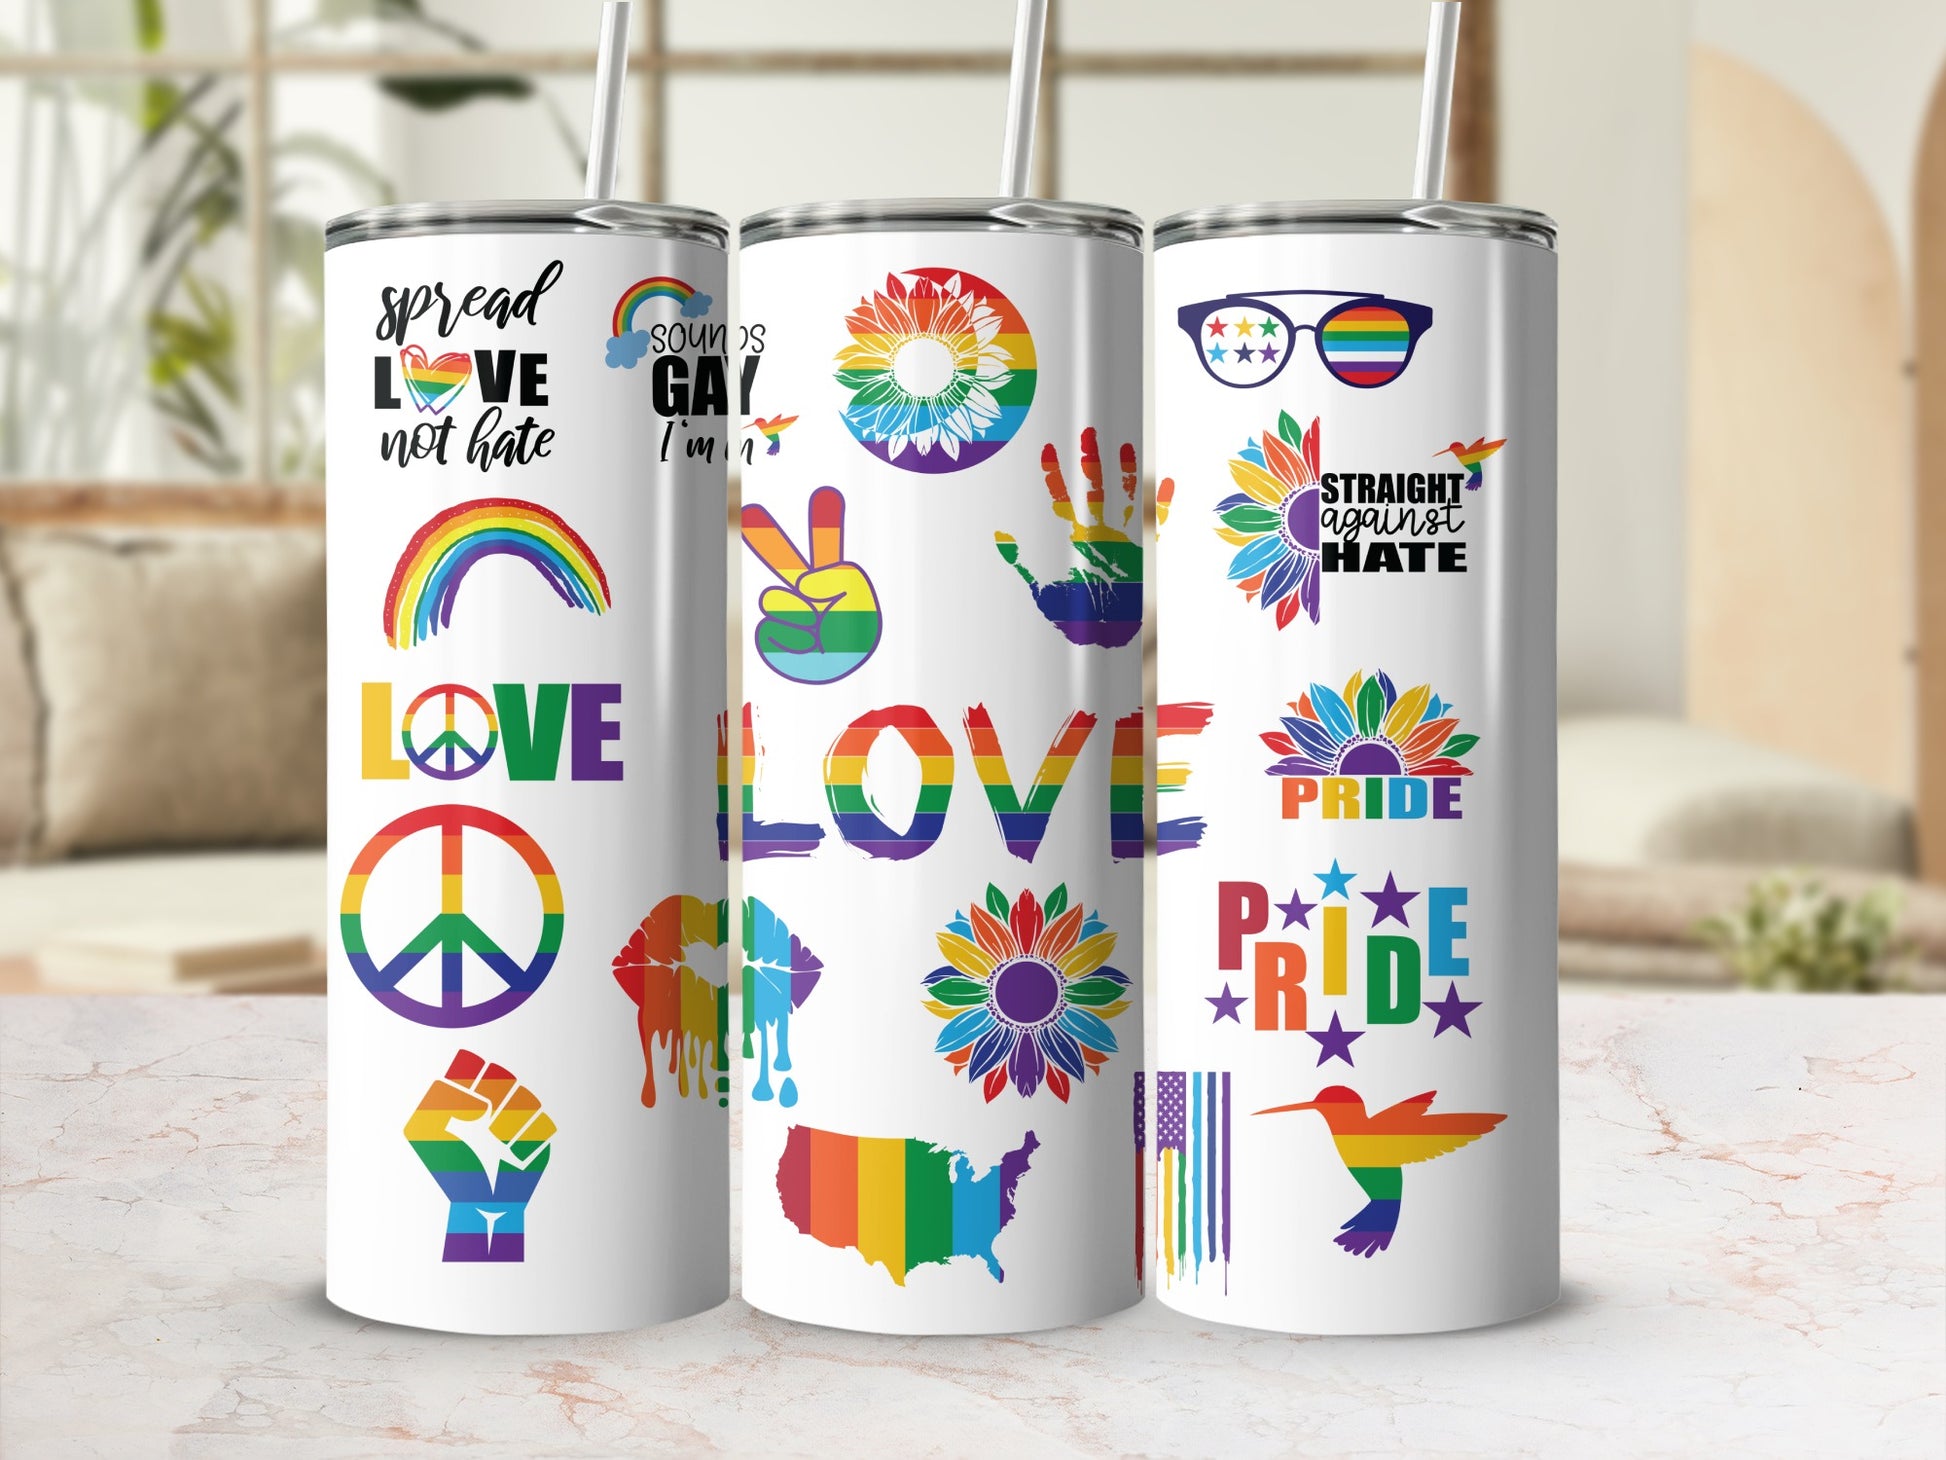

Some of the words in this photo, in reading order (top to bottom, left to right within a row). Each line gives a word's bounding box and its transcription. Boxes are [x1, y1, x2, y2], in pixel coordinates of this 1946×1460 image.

[376, 260, 564, 346] spread
[381, 415, 457, 468] not
[466, 406, 556, 472] hate
[1320, 473, 1465, 504] STRAIGHT
[1320, 497, 1465, 543] against
[1321, 542, 1468, 573] HATE
[717, 702, 1214, 864] LOVE
[1281, 777, 1463, 819] PRIDE
[1218, 881, 1470, 1031] PRIDE
